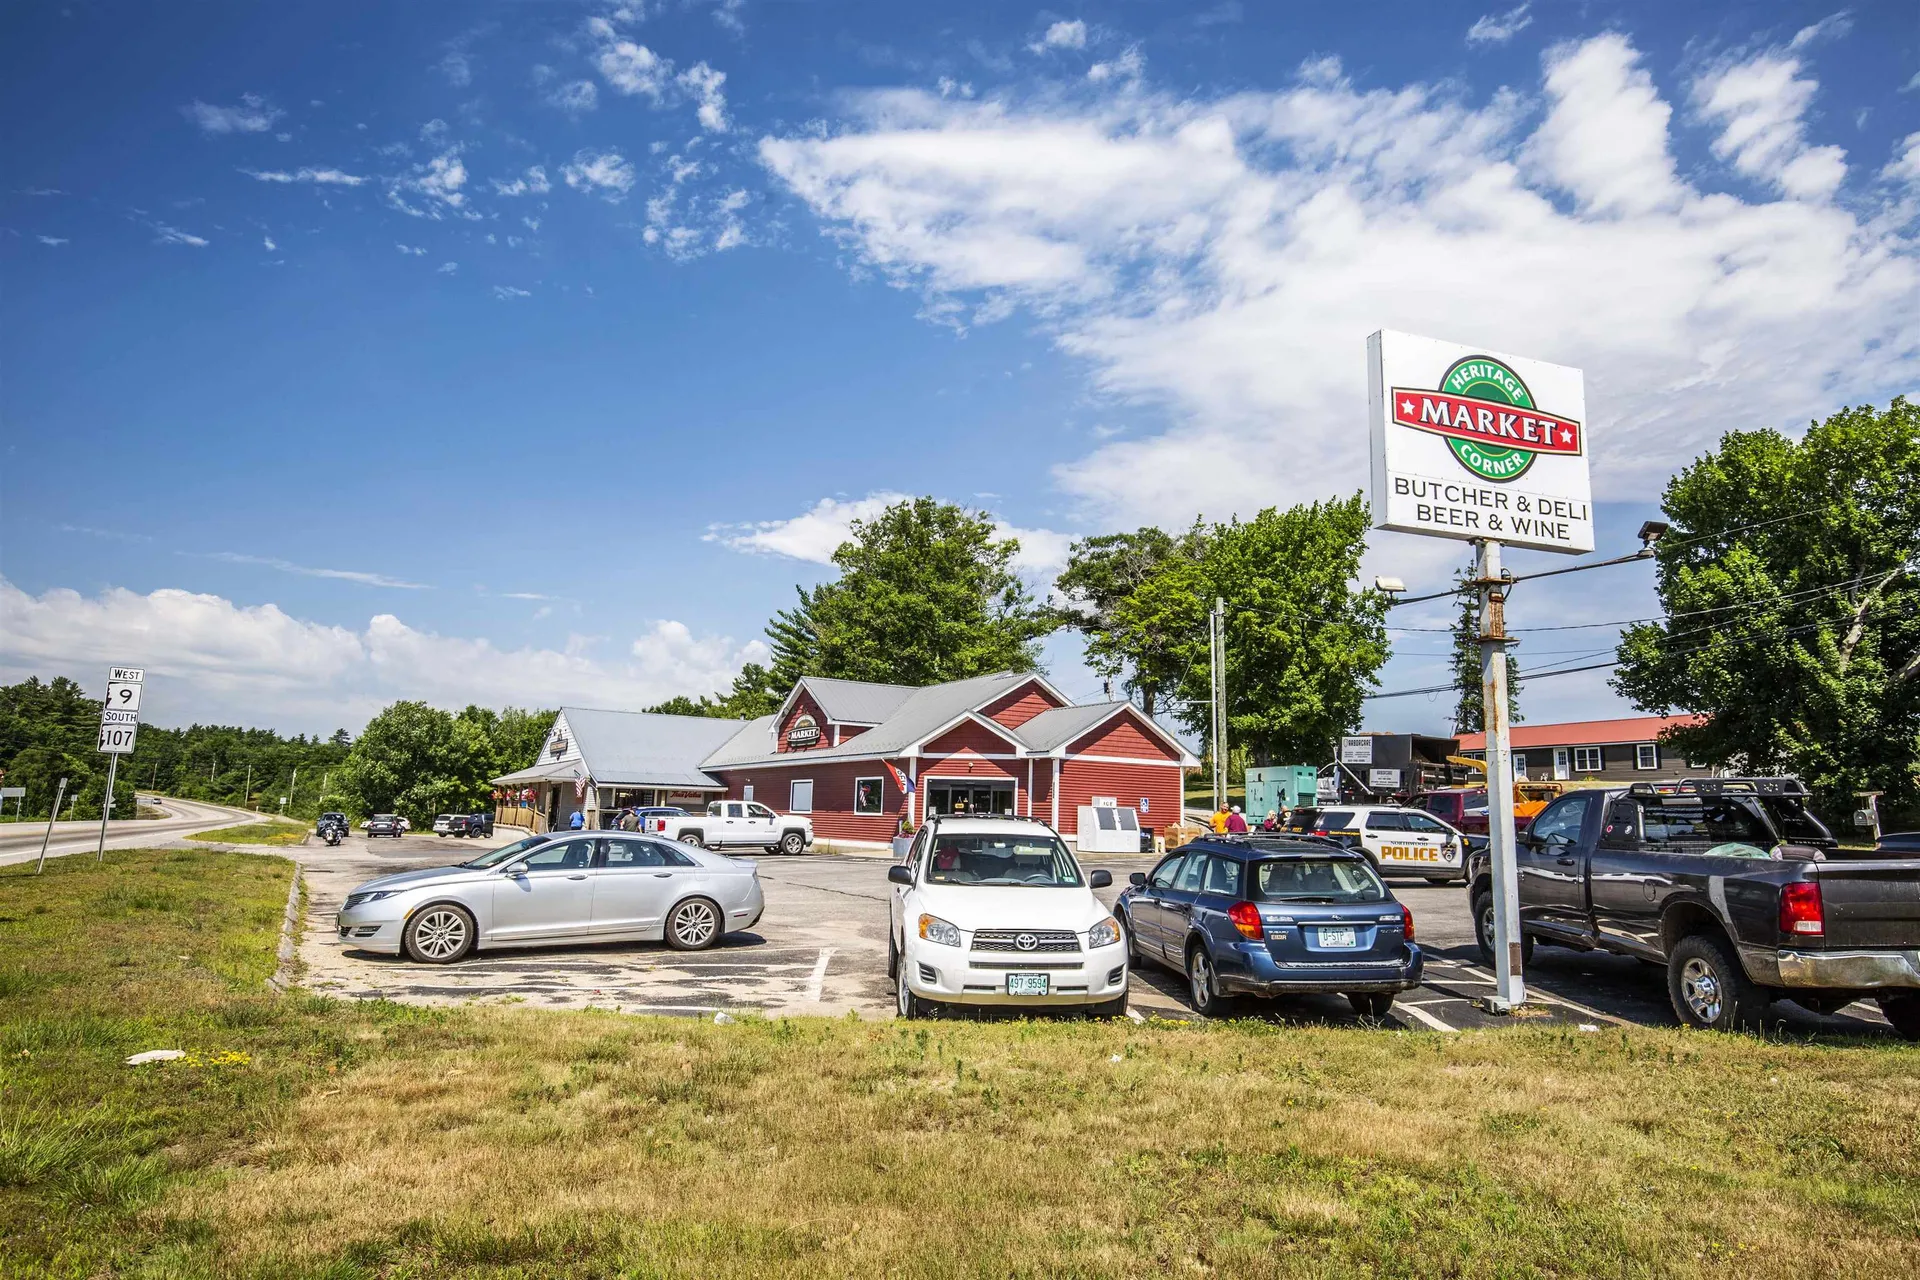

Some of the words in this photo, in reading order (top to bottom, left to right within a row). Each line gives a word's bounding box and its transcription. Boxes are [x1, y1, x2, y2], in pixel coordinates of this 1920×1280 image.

[1451, 364, 1524, 401] HERITAGE
[1420, 397, 1558, 446] MARKET
[1460, 444, 1524, 474] CORNER
[1395, 477, 1509, 510] BUTCHER
[1517, 496, 1531, 513] &
[1538, 498, 1588, 521] DELI
[1417, 503, 1480, 528] BEER
[1488, 513, 1503, 531] &
[1511, 516, 1570, 540] WINE
[114, 669, 140, 680] WEST
[120, 689, 133, 704] 9
[104, 711, 137, 722] SOUTH
[106, 730, 133, 746] 107
[790, 729, 817, 740] MARKET
[1381, 846, 1439, 862] POLICE
[1010, 978, 1024, 988] 497
[1027, 978, 1046, 988] 9594
